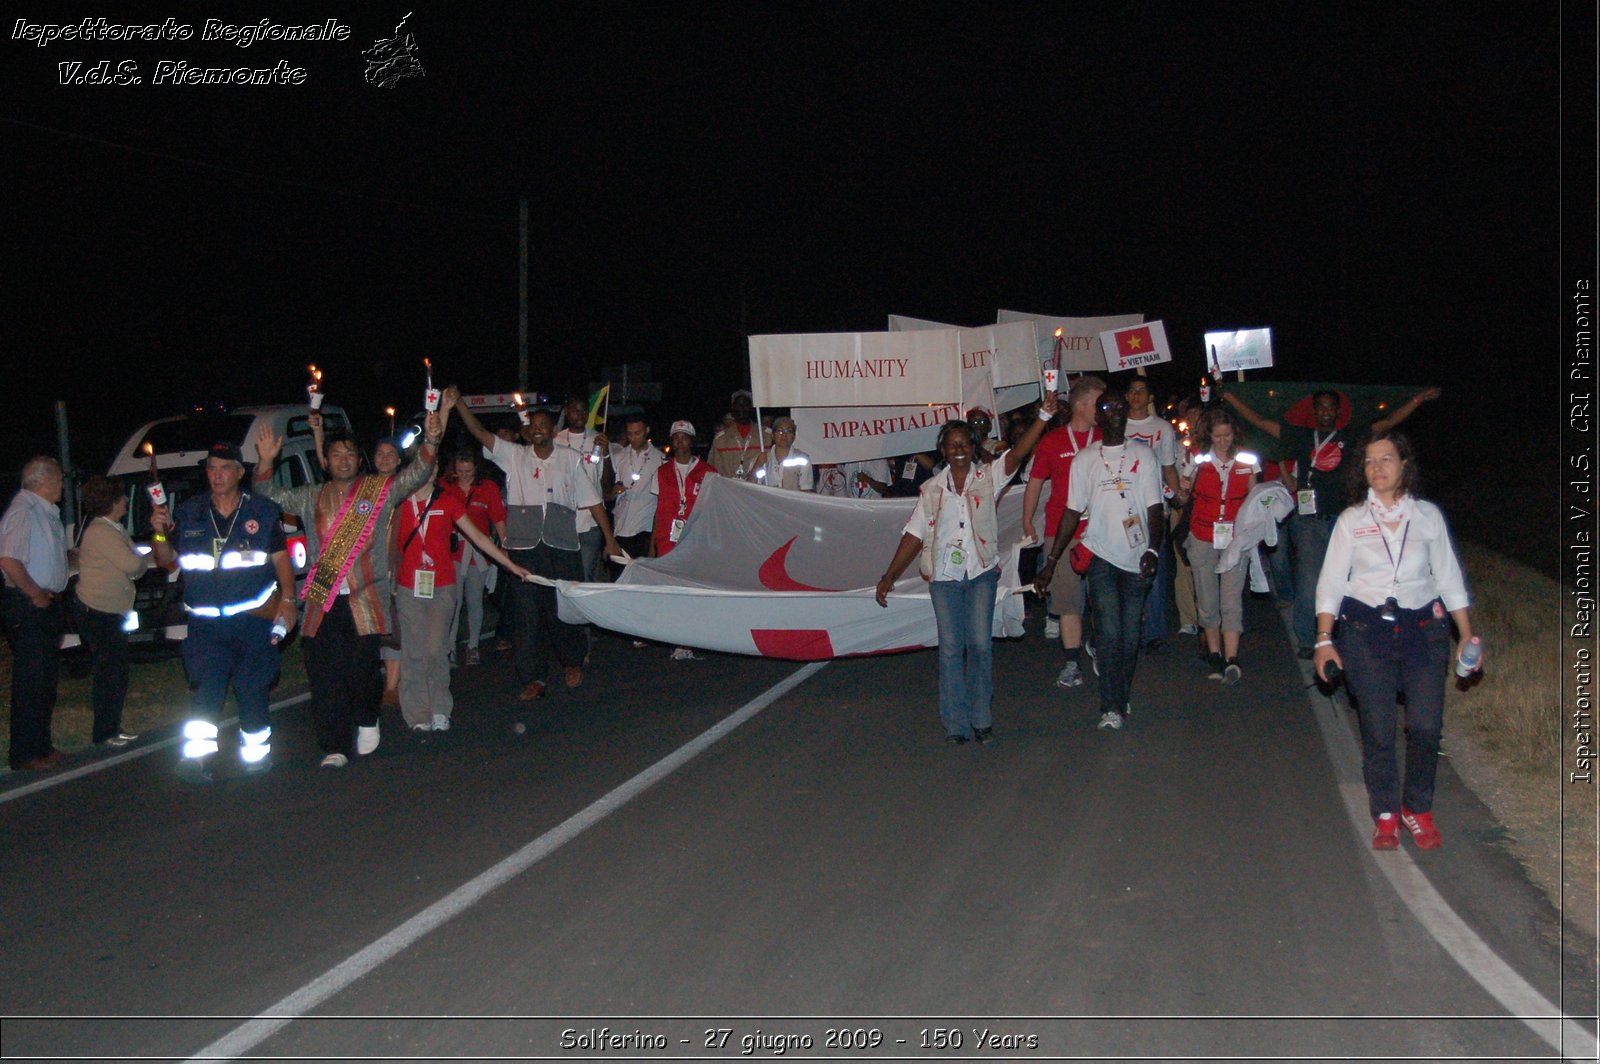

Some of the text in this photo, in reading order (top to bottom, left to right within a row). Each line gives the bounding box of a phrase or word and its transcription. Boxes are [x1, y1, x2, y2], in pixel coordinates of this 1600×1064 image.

[1061, 336, 1094, 351] NITY
[806, 358, 909, 379] HUMANITY
[961, 348, 998, 369] LITY
[1127, 353, 1161, 366] VIET NAM
[822, 402, 963, 439] IMPARTIALITY
